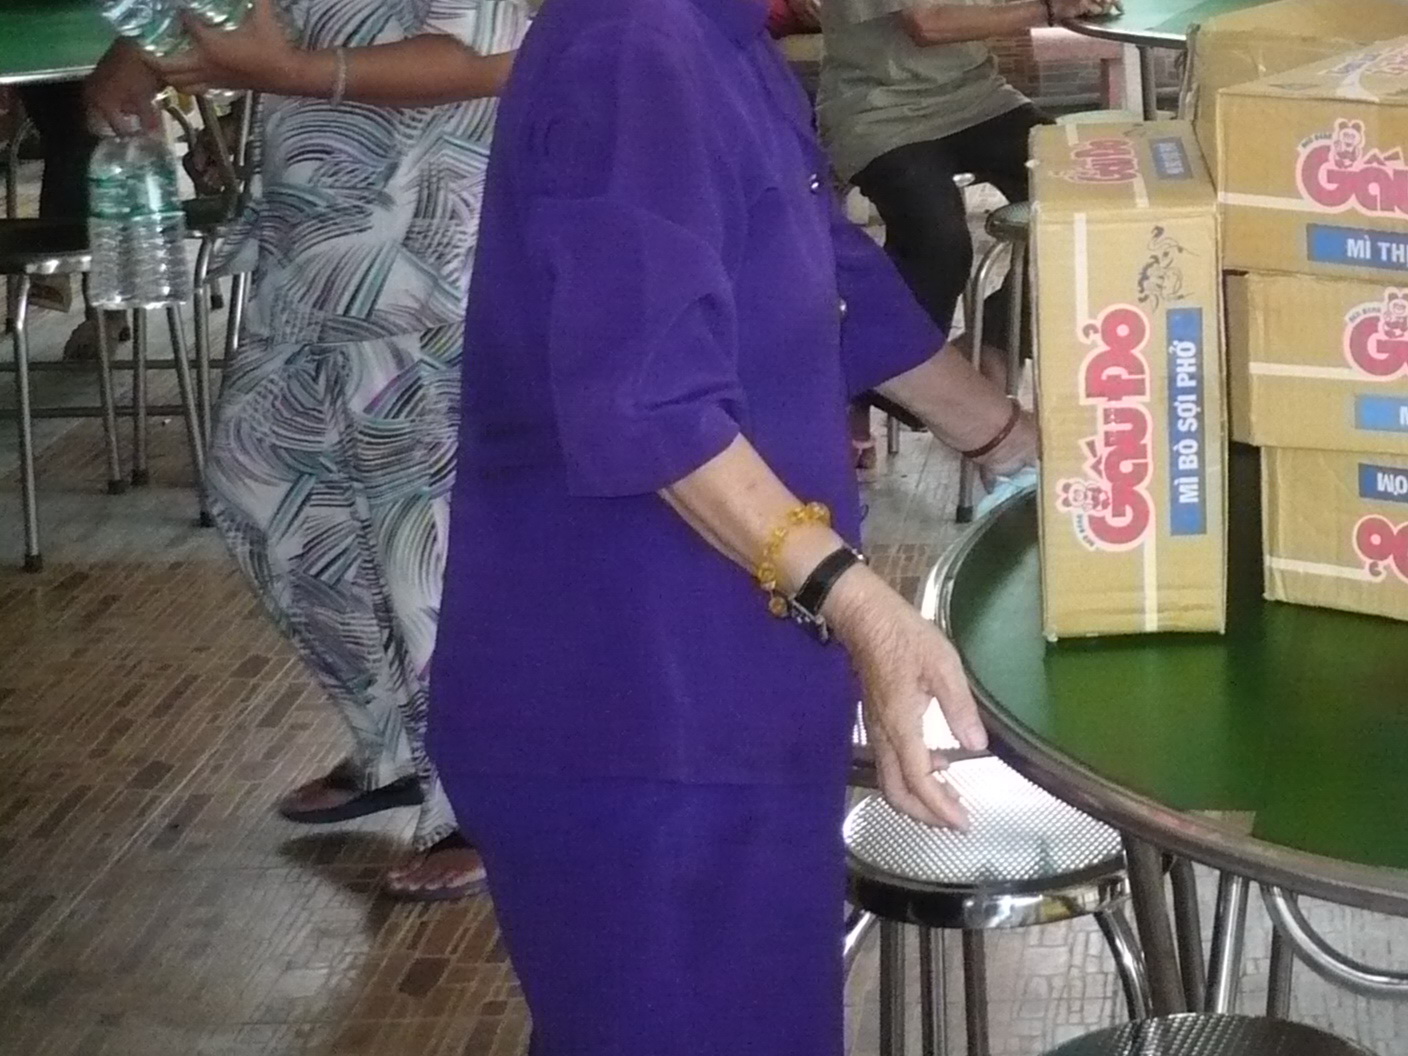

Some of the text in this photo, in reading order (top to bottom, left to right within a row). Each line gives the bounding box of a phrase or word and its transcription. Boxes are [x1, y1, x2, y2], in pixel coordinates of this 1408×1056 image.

[1347, 235, 1372, 260] MÌ
[1169, 340, 1202, 504] MÌ BÒ SỢI PHỞ
